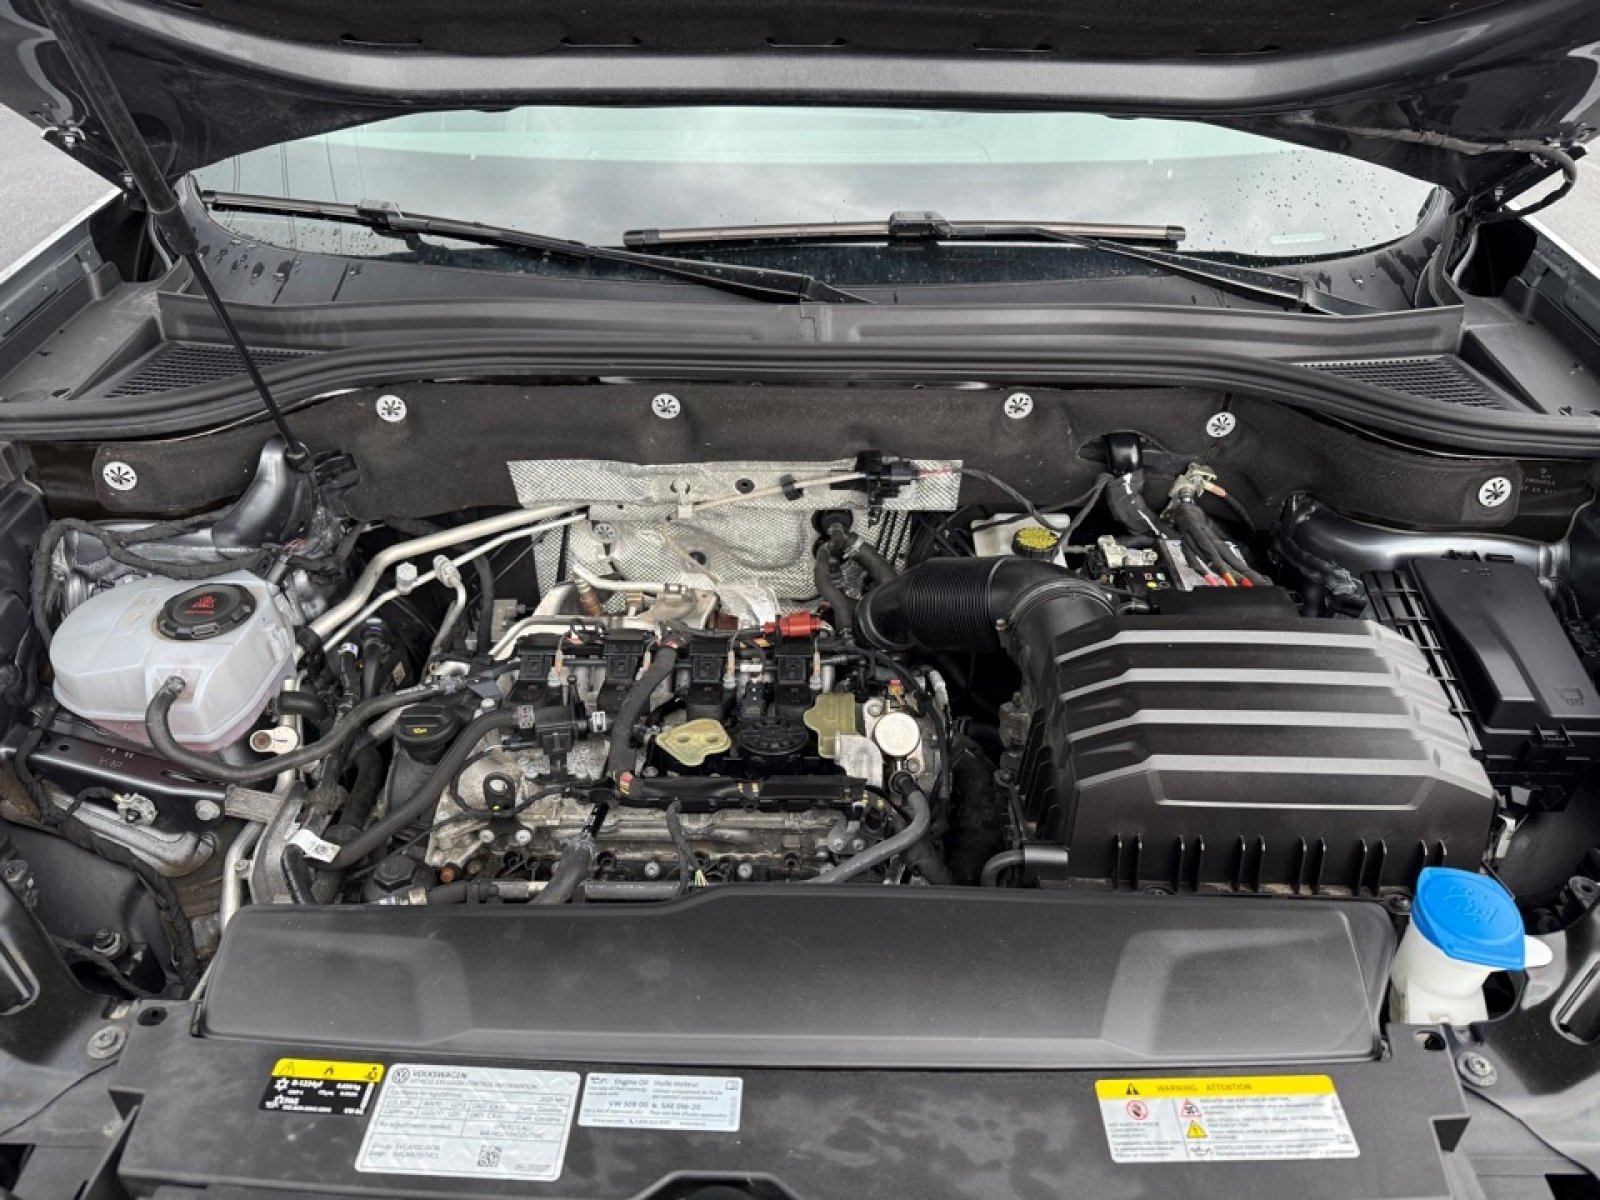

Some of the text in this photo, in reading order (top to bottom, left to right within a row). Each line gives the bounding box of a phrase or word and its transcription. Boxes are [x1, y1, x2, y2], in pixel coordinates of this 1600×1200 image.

[412, 1070, 468, 1080] VOLKSWAGEN
[1156, 1082, 1253, 1093] WARNING ATTENTION
